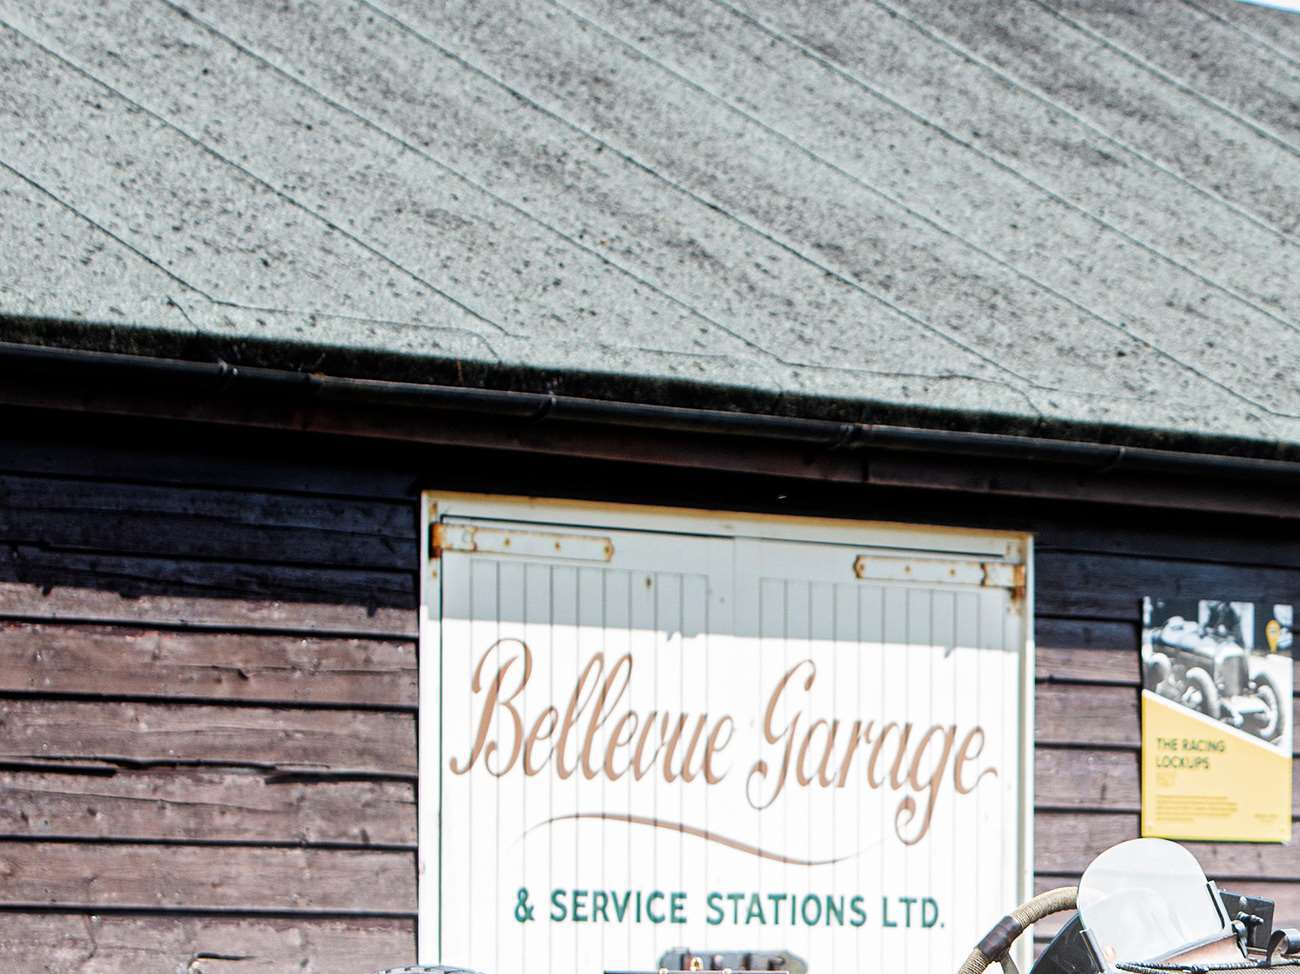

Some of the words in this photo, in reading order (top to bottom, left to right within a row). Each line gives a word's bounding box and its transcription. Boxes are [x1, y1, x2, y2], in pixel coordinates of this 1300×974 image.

[449, 637, 735, 785] Bellevue
[745, 658, 999, 847] Garage
[1156, 737, 1178, 751] THE
[1182, 738, 1225, 753] RACING
[1155, 755, 1210, 769] LOCKUPS
[514, 887, 536, 924] &
[549, 888, 688, 925] SERVICE
[705, 893, 868, 928] STATIONS
[880, 897, 946, 930] LTD.
